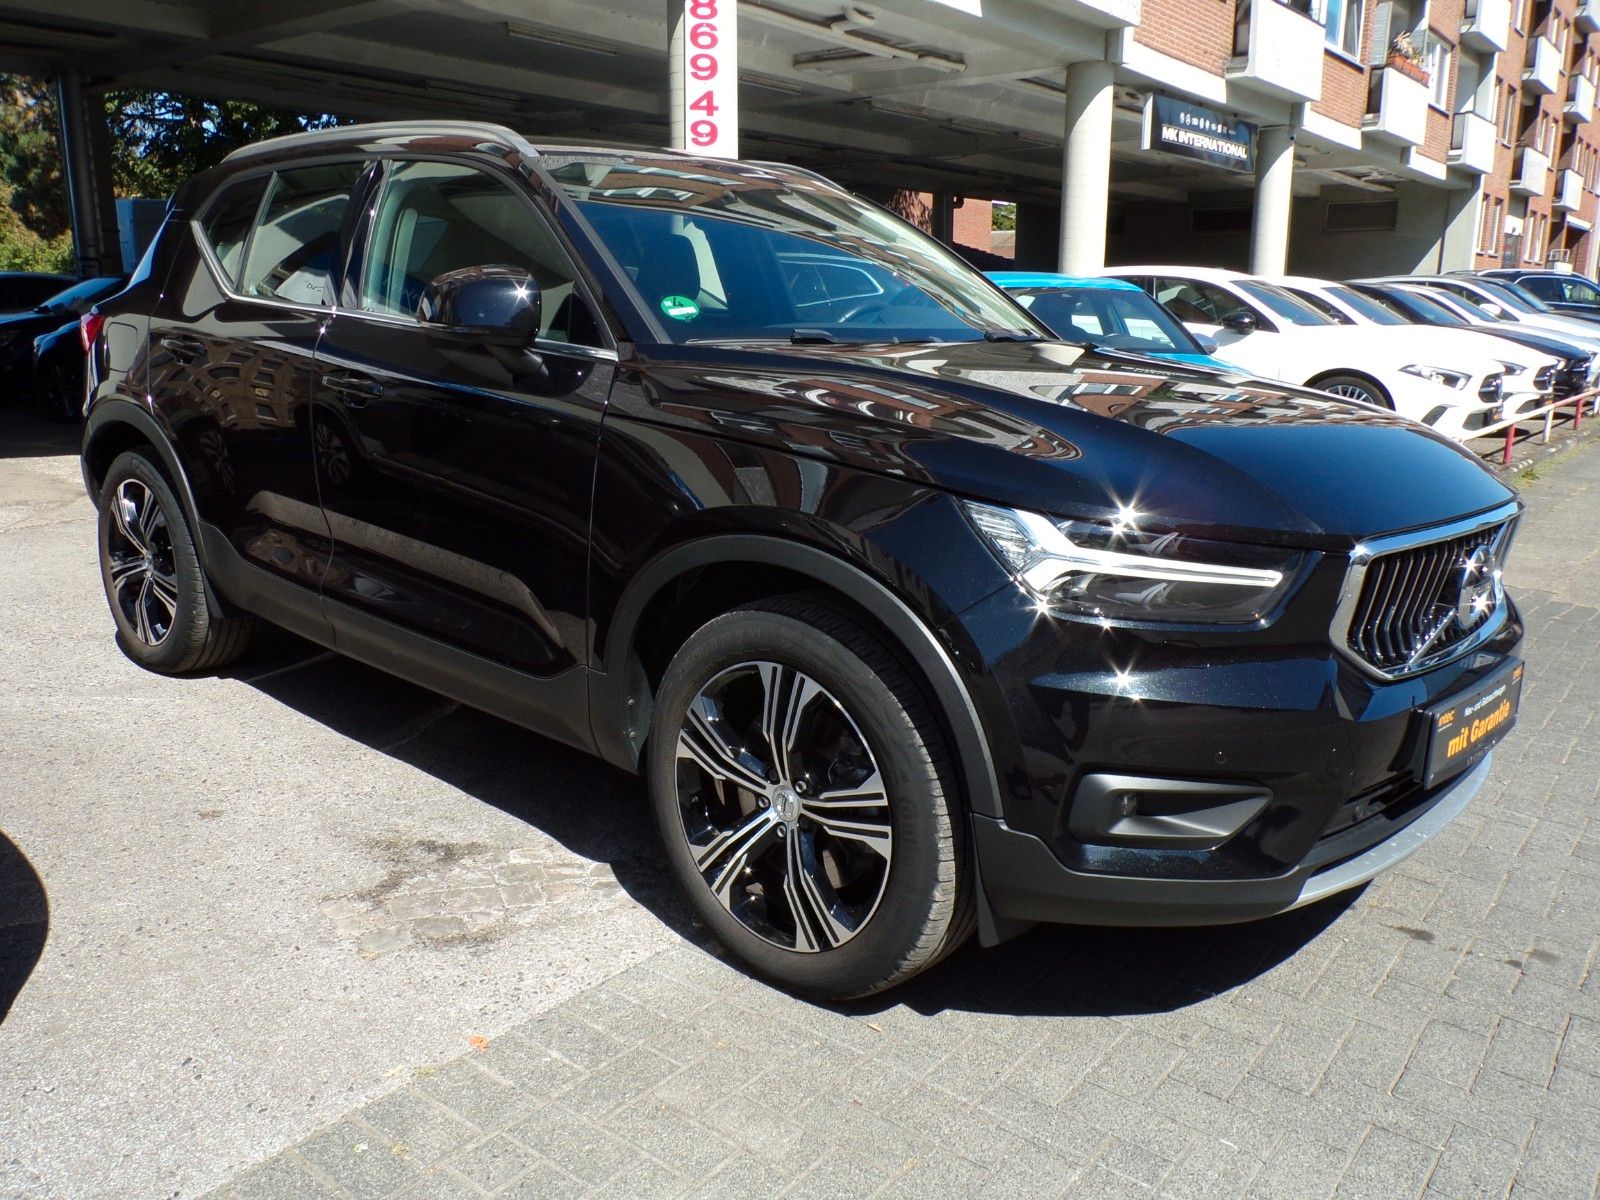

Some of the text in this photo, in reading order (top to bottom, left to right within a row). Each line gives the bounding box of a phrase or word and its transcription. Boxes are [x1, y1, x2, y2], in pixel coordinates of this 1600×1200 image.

[1162, 126, 1247, 158] MK INTERNATIONAL
[1447, 727, 1470, 758] mit
[1470, 698, 1511, 743] Garantie
